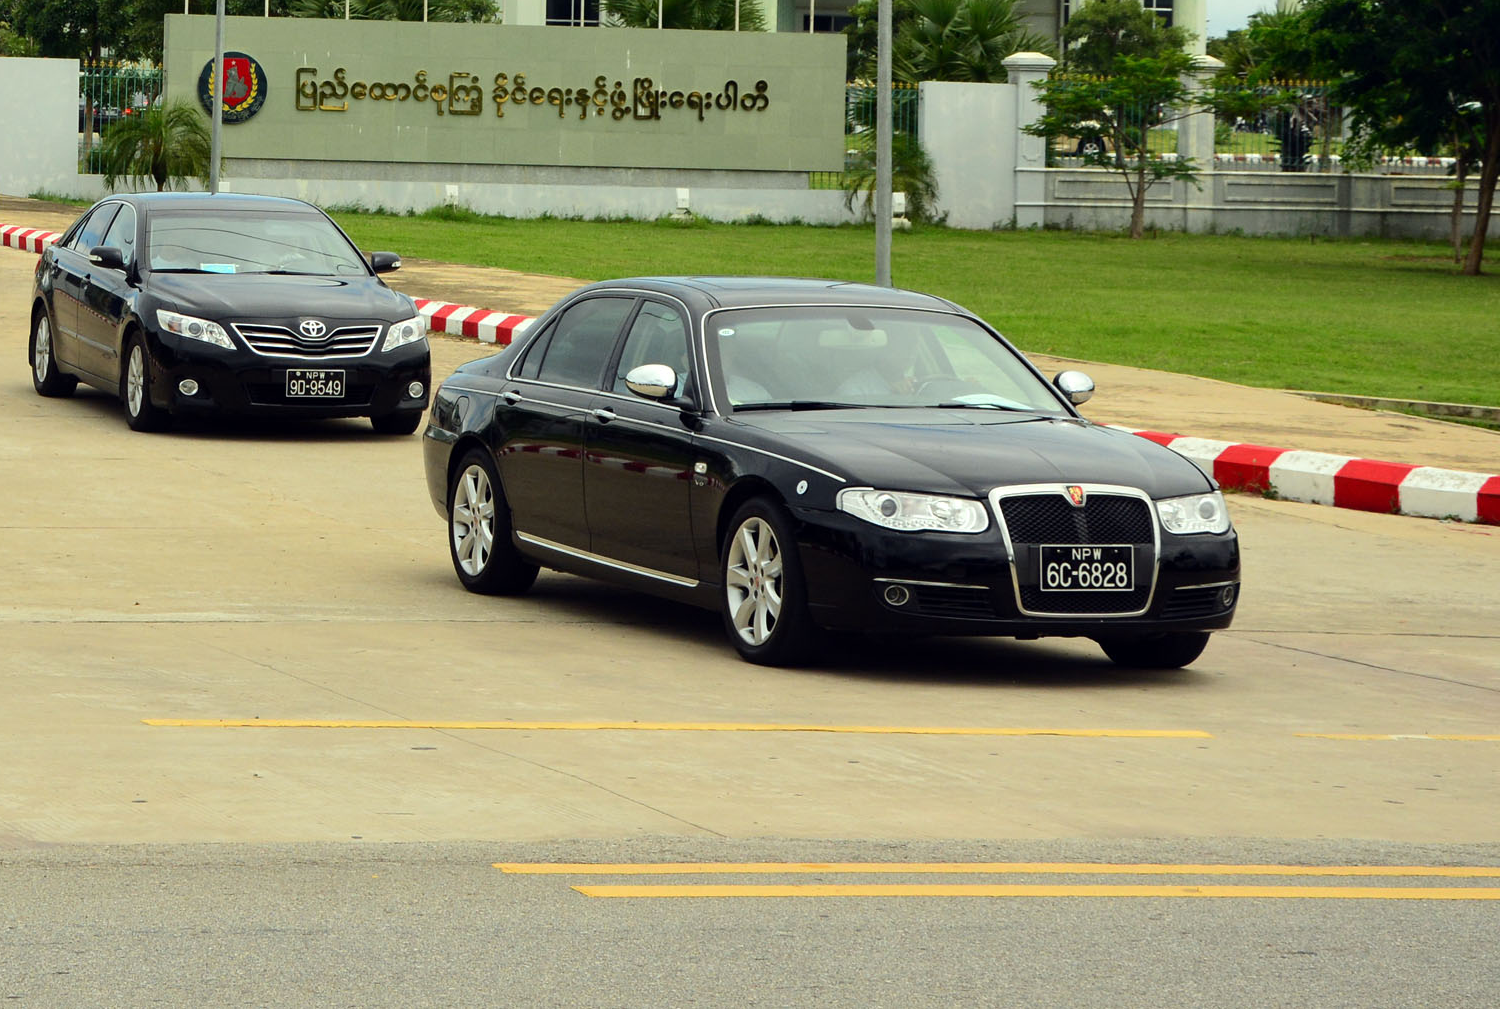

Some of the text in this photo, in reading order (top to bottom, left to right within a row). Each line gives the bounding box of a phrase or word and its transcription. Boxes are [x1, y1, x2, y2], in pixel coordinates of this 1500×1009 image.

[306, 371, 326, 379] NPW
[1071, 548, 1102, 560] NPW
[1047, 563, 1128, 587] 6C-6828
